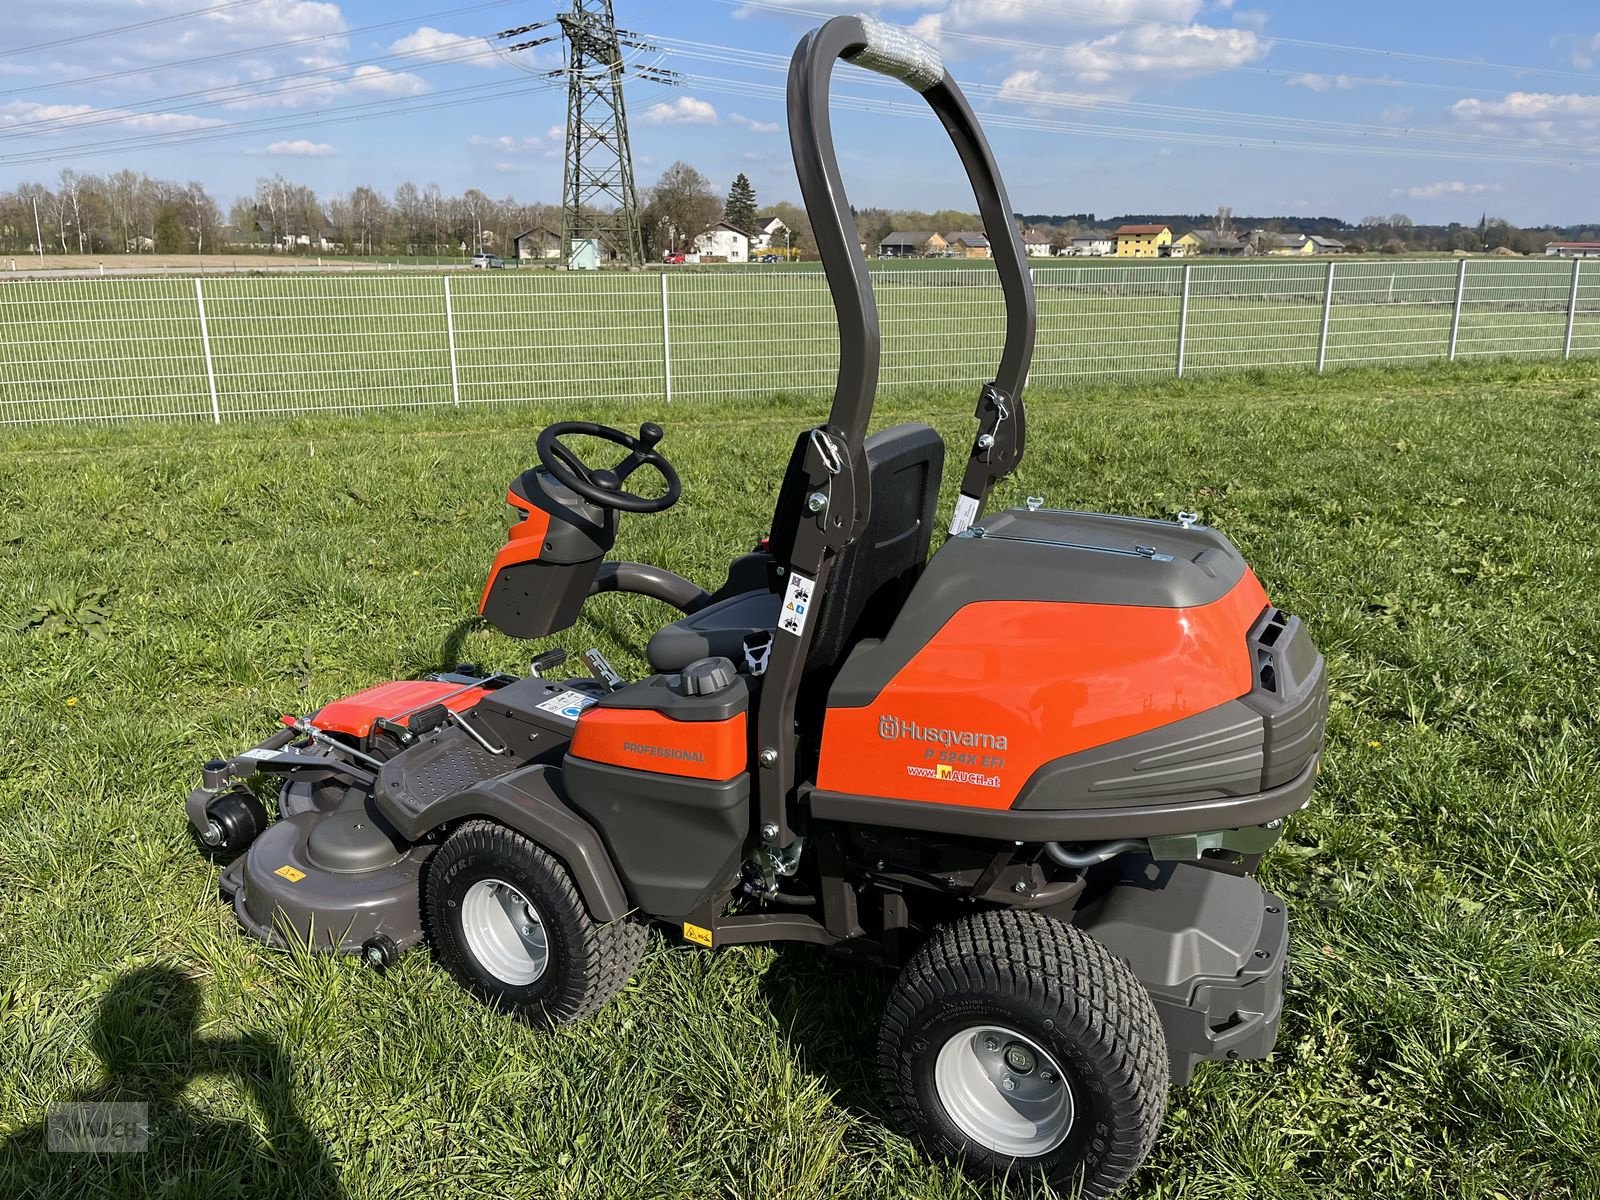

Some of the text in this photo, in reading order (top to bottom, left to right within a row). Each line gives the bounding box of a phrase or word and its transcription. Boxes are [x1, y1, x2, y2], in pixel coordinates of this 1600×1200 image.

[900, 720, 1008, 750] Husqvarna
[623, 742, 705, 763] PROFESSIONAL
[925, 748, 1006, 769] P 524X EFI
[443, 855, 476, 884] TURF
[1085, 1121, 1109, 1167] 505
